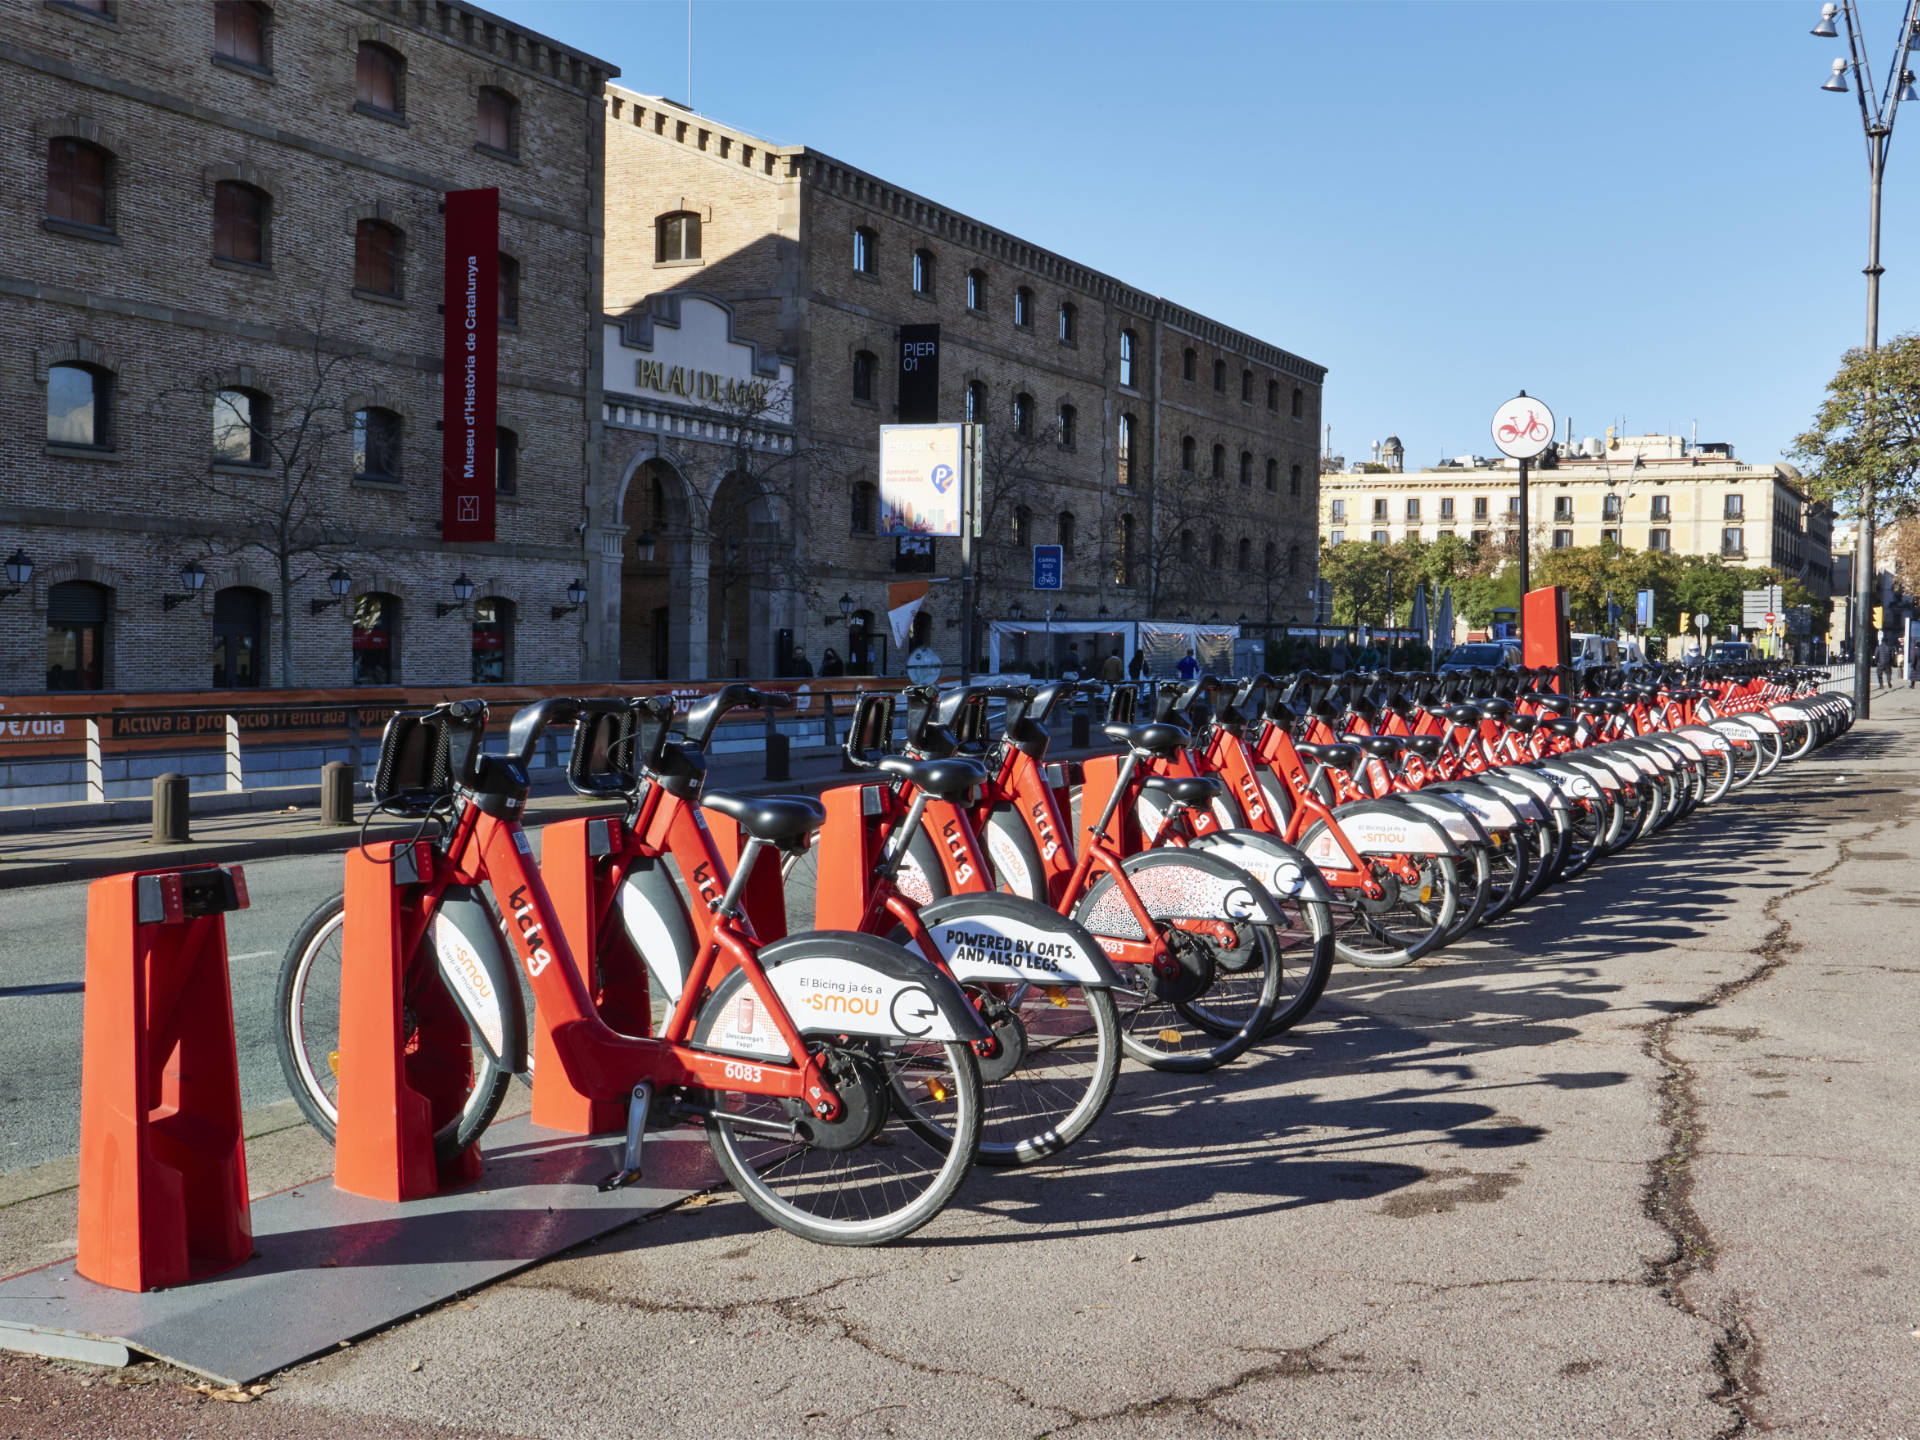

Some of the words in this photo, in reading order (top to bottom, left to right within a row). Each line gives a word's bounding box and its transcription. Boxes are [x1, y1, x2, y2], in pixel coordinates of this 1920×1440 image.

[465, 255, 479, 330] Catalunya
[465, 332, 476, 352] de
[903, 342, 936, 356] PIER
[636, 358, 695, 396] PALAU
[700, 371, 724, 403] DE
[728, 376, 768, 409] MAR
[902, 357, 918, 371] 01
[463, 355, 476, 426] d'Història
[463, 429, 476, 479] Museu
[1239, 773, 1263, 820] bicing
[1030, 801, 1057, 861] bicing
[1367, 832, 1406, 843] smou
[942, 819, 973, 885] bicing
[509, 884, 551, 977] bicing
[945, 929, 1012, 951] POWERED
[1015, 939, 1035, 954] BY
[1037, 942, 1076, 960] OATS.
[457, 949, 491, 998] smou
[956, 946, 985, 962] AND
[987, 950, 1023, 968] ALSO
[1026, 955, 1063, 973] LEGS.
[799, 977, 809, 987] El
[811, 979, 845, 993] Bicing
[847, 983, 858, 994] ja
[860, 982, 872, 993] és
[811, 993, 879, 1016] smou
[724, 1063, 762, 1083] 6083
